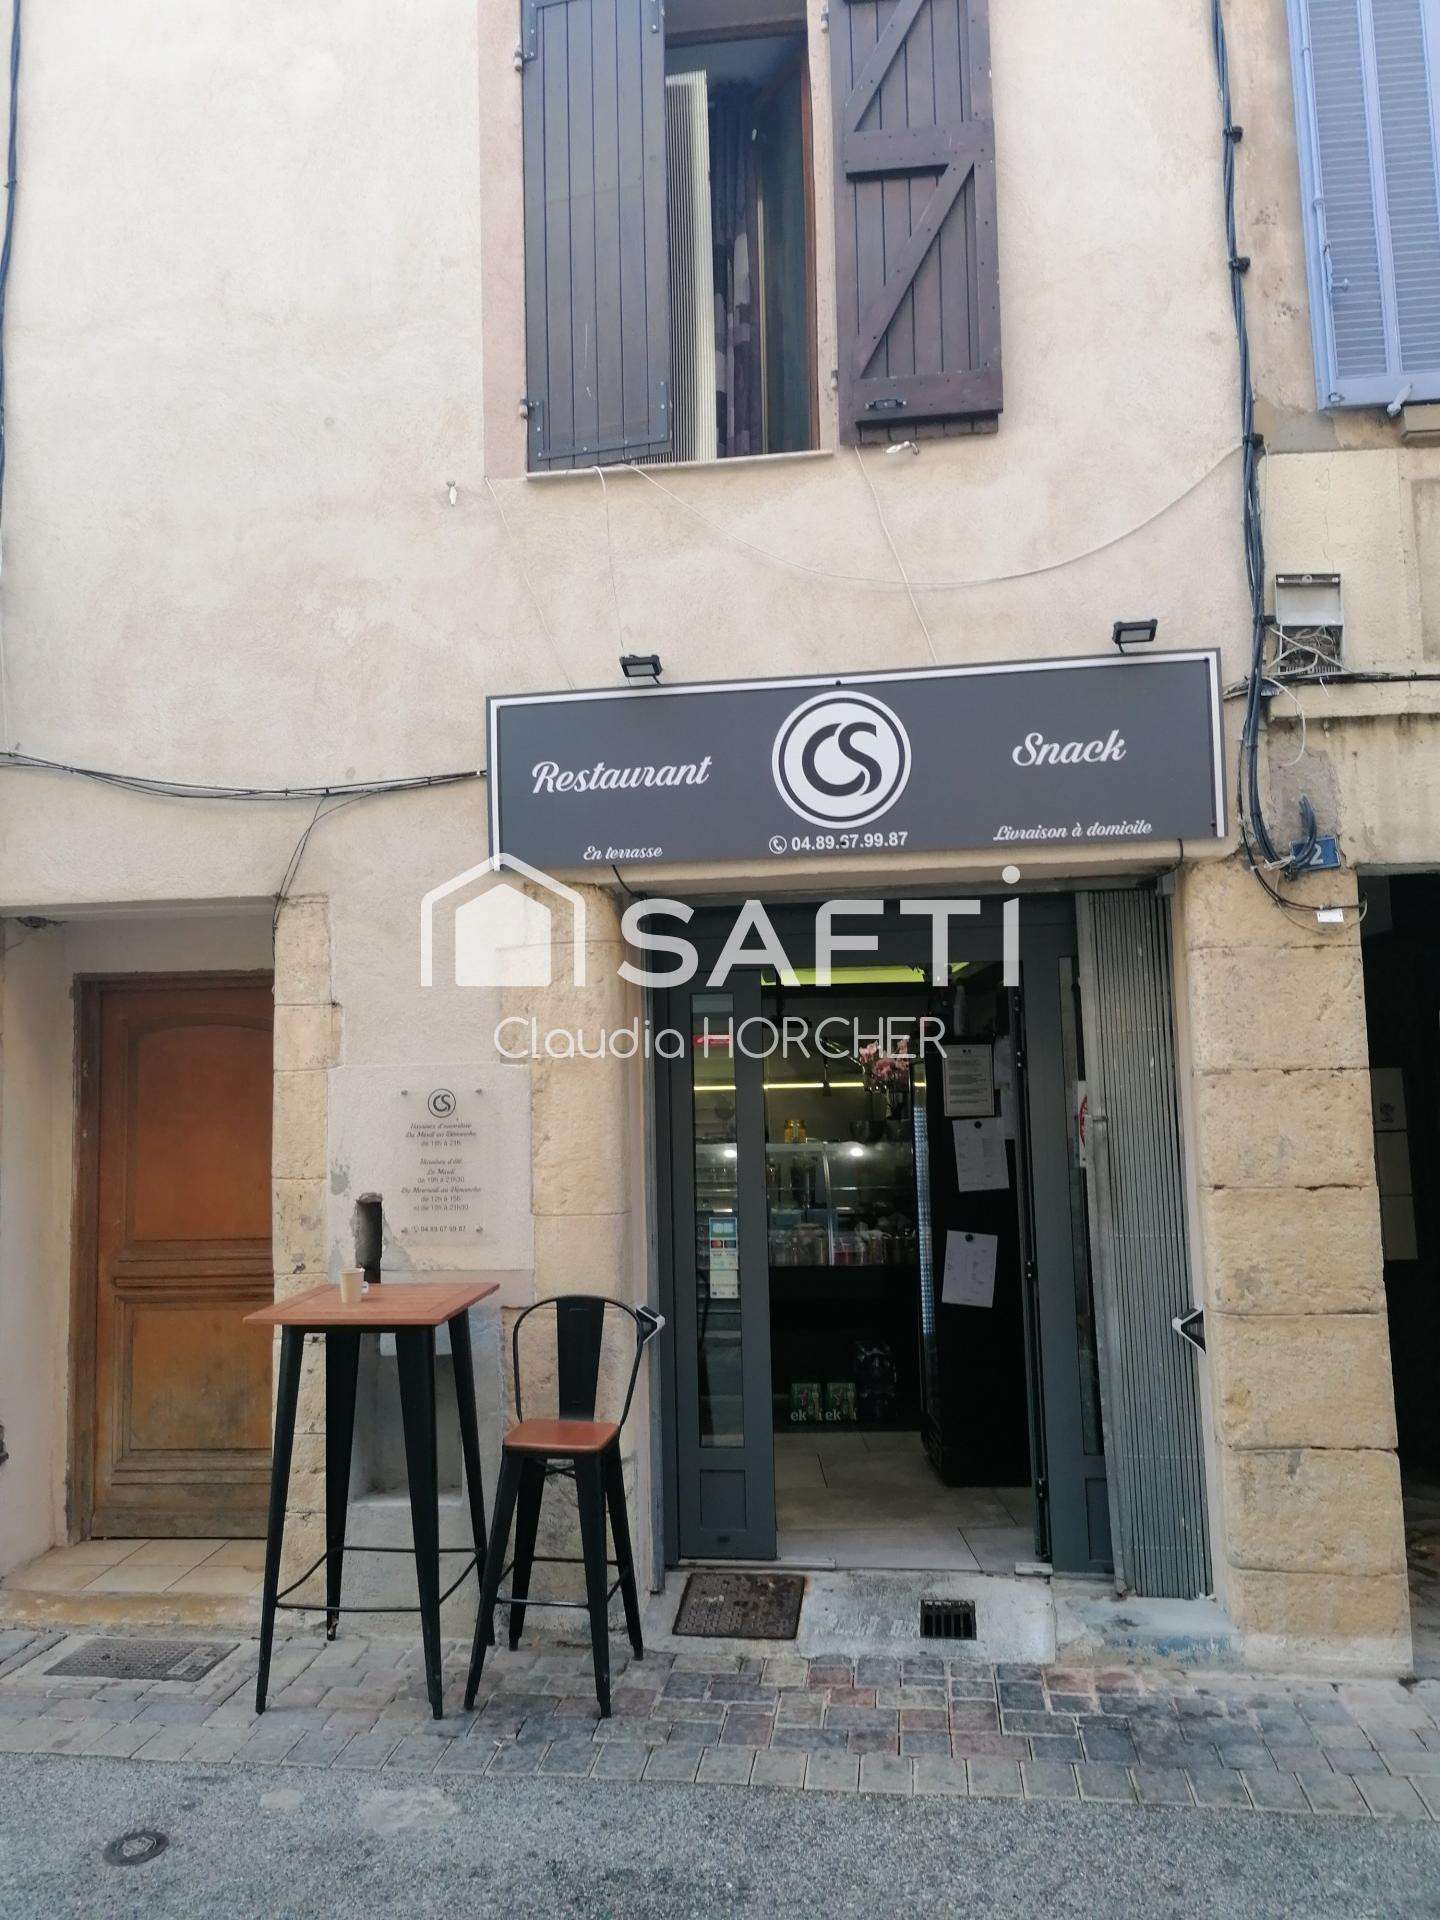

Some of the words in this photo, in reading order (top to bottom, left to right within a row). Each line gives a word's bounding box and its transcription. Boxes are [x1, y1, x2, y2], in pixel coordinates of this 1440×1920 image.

[1012, 729, 1127, 767] Snack
[531, 755, 713, 794] Restaurant
[992, 825, 1068, 841] Livraison
[1071, 822, 1083, 838] à
[1086, 819, 1153, 837] domicile
[583, 845, 603, 861] En
[605, 845, 663, 860] terrasse
